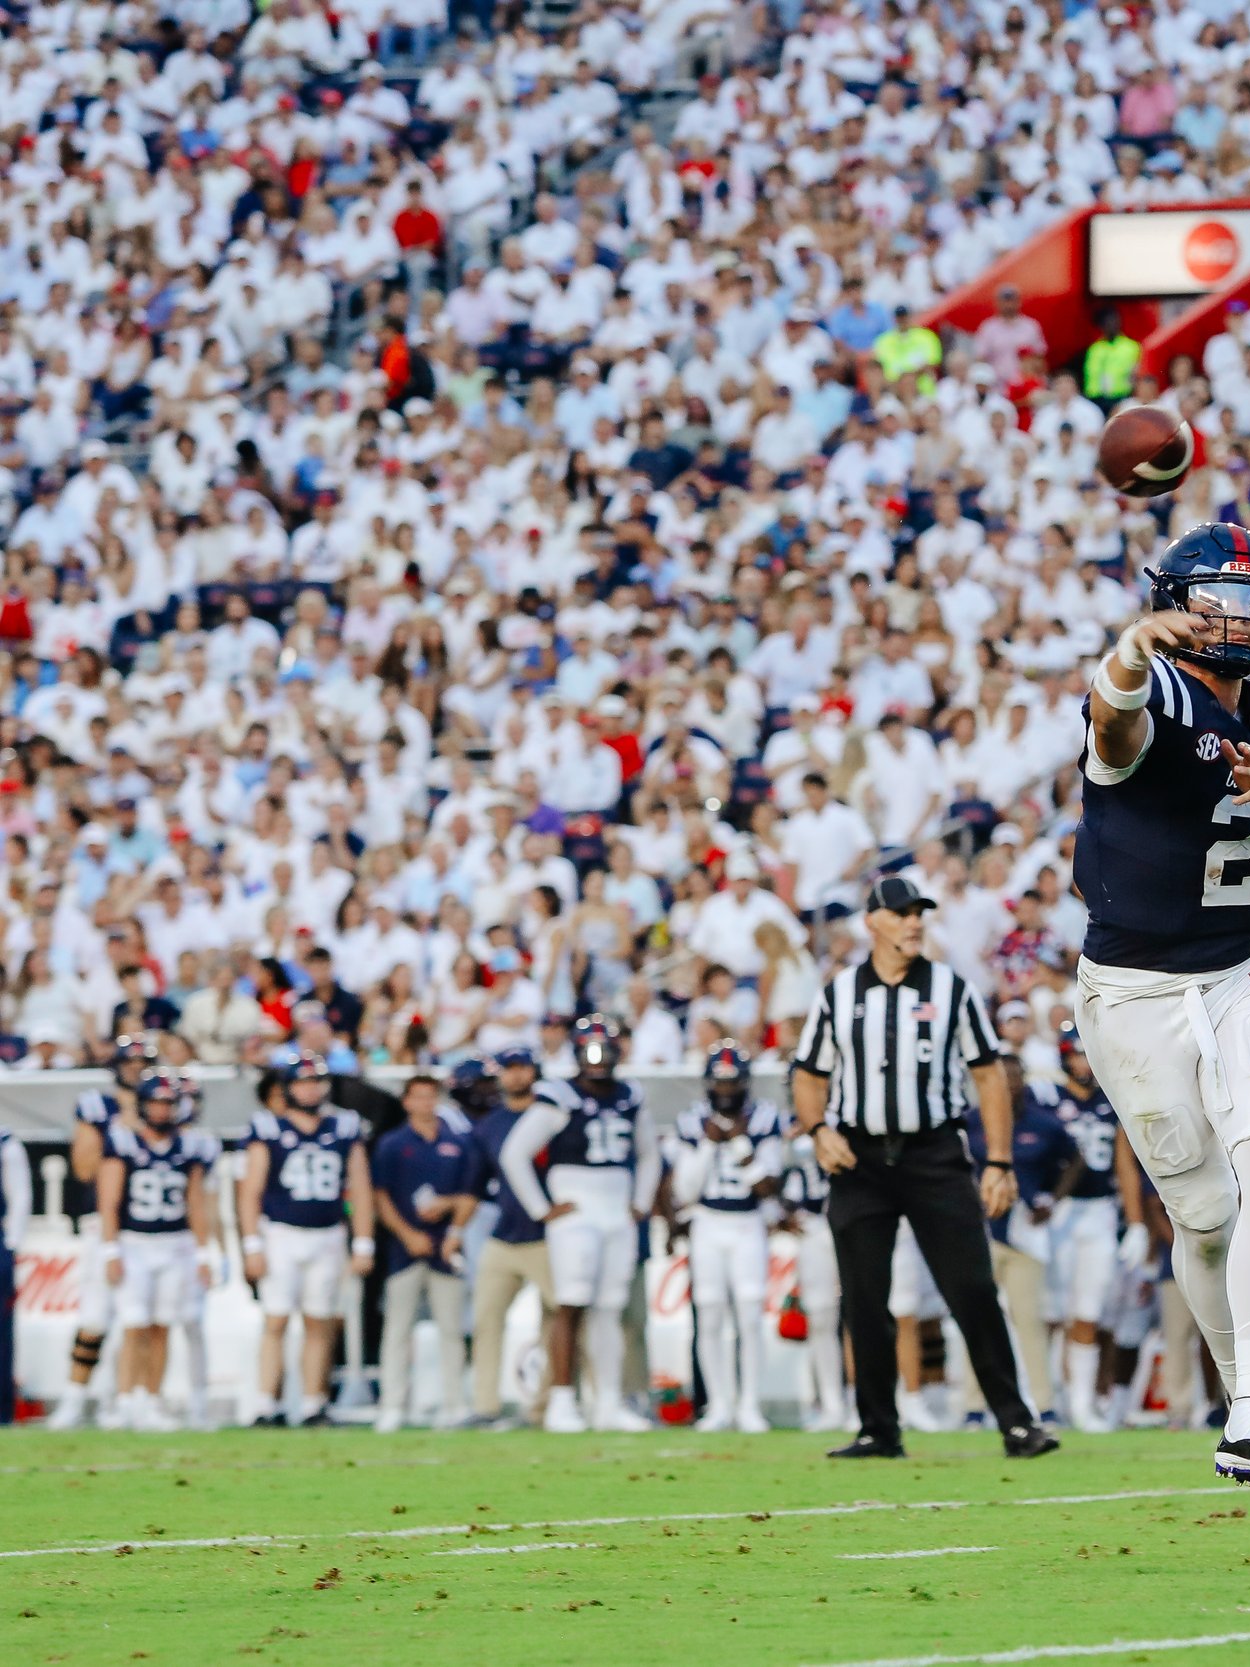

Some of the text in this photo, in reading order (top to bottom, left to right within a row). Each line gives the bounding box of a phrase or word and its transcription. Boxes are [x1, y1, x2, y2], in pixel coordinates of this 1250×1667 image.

[1195, 732, 1221, 761] SEC
[917, 1039, 935, 1063] C
[128, 1168, 187, 1222] 93
[280, 1150, 342, 1201] 48
